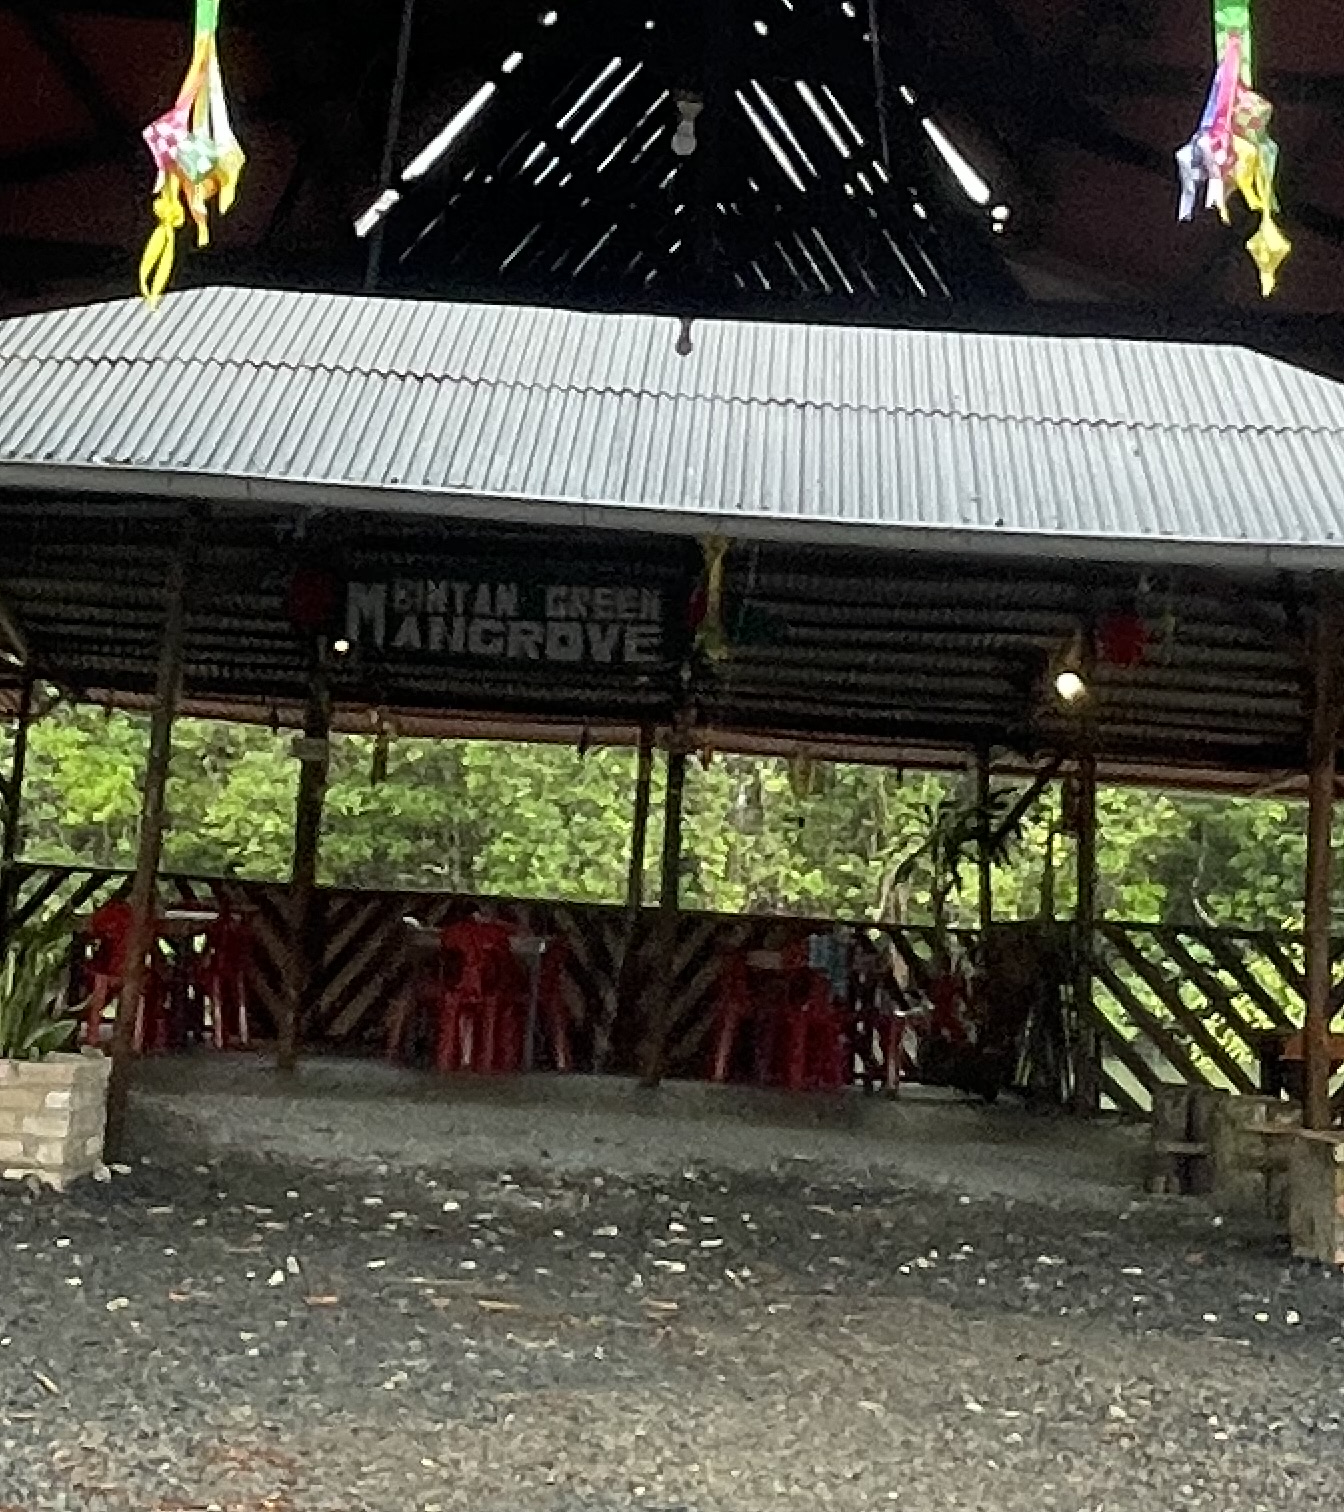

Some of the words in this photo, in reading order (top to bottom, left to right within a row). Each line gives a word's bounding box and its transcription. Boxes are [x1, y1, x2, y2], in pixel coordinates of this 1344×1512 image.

[346, 581, 663, 662] MANGROVE
[393, 578, 518, 617] BINTAN
[545, 584, 662, 621] GREEN
